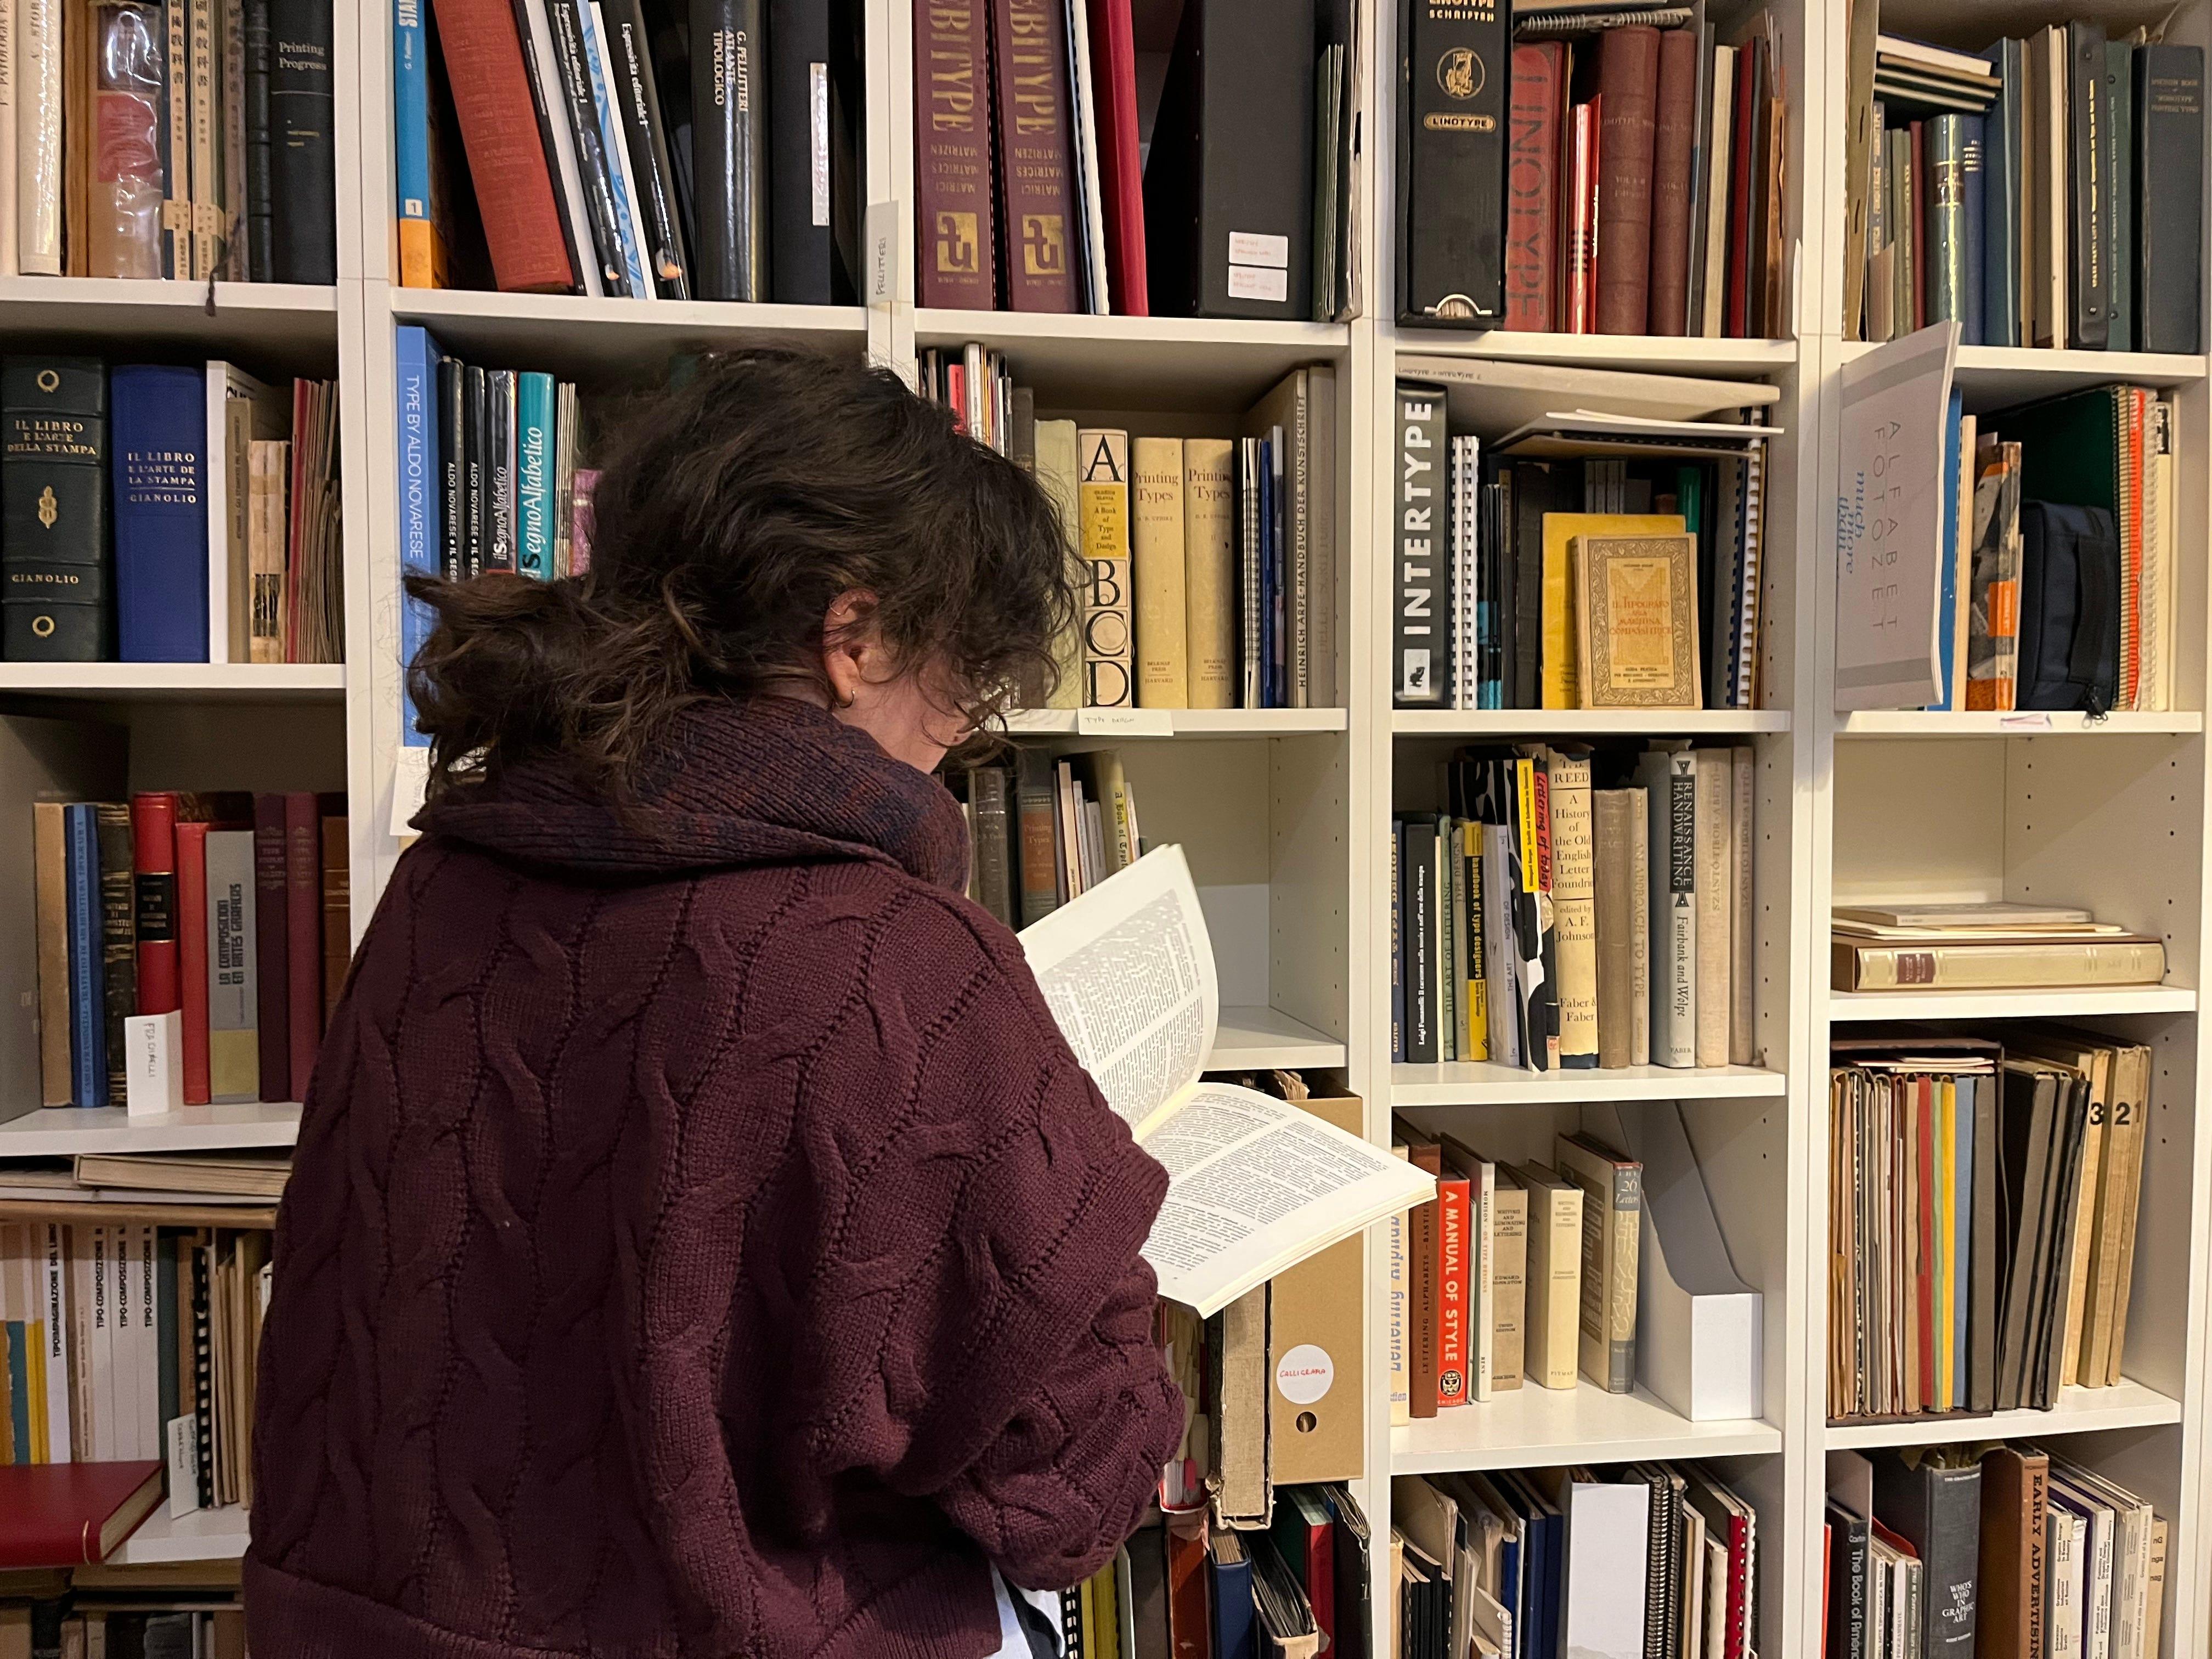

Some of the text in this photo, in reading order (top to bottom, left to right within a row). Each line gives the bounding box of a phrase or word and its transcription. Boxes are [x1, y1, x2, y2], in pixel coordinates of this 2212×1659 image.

[1429, 9, 1494, 22] SCHRIFTEN
[279, 41, 325, 56] Printing
[279, 57, 327, 71] Progress
[714, 30, 725, 105] TIPOLOGICO
[737, 30, 748, 112] G. PELLITTERI
[1432, 117, 1488, 127] LINOTYPE
[929, 144, 978, 158] MATRIZEN
[1014, 146, 1062, 160] MATRIZEN
[1015, 165, 1064, 178] MATRICES
[935, 182, 977, 194] MATRICI
[1021, 183, 1061, 195] MATRICI
[1509, 75, 1548, 317] LINOTYPE
[410, 202, 418, 214] 1
[15, 420, 84, 432] IL LIBRO
[24, 432, 74, 443] E L'ARTE
[1296, 394, 1306, 485] KUNSTSCHRIFT
[7, 443, 97, 455] DELLA STAMPA
[128, 452, 195, 462] IL LIBRO
[138, 465, 195, 475] L'ARTE DE
[406, 375, 424, 559] TYPE BY ALDO NOVARESE
[147, 476, 195, 486] STAMPA
[130, 493, 197, 504] GIANOLIO
[1138, 487, 1174, 504] Types
[1194, 485, 1231, 501] Types
[448, 462, 457, 556] ALDO NOVARESE IL
[471, 462, 479, 555] ALDO NOVARESE IL
[1296, 490, 1305, 514] DER
[1854, 471, 1865, 539] much
[492, 466, 511, 561] ilSegnoAlfabetico
[1404, 402, 1432, 635] INTERTYPE
[1098, 524, 1114, 534] Type
[1096, 542, 1117, 551] Design
[1846, 512, 1854, 574] more
[11, 574, 79, 584] GIANOLIO
[1297, 629, 1306, 688] HEINRICH
[1087, 660, 1129, 707] D
[1554, 771, 1588, 785] REED
[1569, 795, 1578, 805] A
[1115, 803, 1126, 837] Book of
[1555, 808, 1590, 820] History
[1536, 775, 1550, 888] Lettering of today
[1568, 822, 1578, 831] of
[1555, 836, 1591, 846] the Old
[1673, 782, 1683, 886] HANDWRITING
[1684, 782, 1692, 886] RENAISSANCE
[1712, 822, 1720, 856] TIBOR
[1556, 850, 1591, 862] English
[1453, 842, 1463, 903] TYPE DESIGN
[1560, 865, 1589, 874] Letter
[1443, 882, 1452, 941] LETTERING
[1473, 901, 1481, 911] of
[1503, 900, 1509, 910] OF
[1559, 905, 1591, 916] edited by
[1472, 914, 1481, 933] type
[1565, 916, 1588, 926] A. F.
[1635, 844, 1645, 998] AN APPROACH TO TYPE
[231, 935, 243, 968] ARTES
[1444, 947, 1451, 961] OF
[1473, 935, 1482, 978] designers
[1674, 916, 1688, 1017] Fairbank and Wolpe
[218, 973, 230, 985] LA
[231, 971, 244, 985] EN
[1560, 998, 1590, 1008] Faber
[1566, 1012, 1594, 1022] Faber
[1418, 1028, 1426, 1045] Luigi
[2090, 1102, 2131, 1125] 3 2
[1620, 1177, 1638, 1192] 26
[1445, 1190, 1459, 1361] A MANUAL OF STYLE
[2032, 1474, 2042, 1536] EARLY
[1851, 1549, 1864, 1619] The Book of
[1949, 1581, 1972, 1593] WHO'S
[1953, 1589, 1970, 1600] WHO
[1942, 1602, 1975, 1617] GRAPHIC
[1957, 1599, 1966, 1607] IN
[1953, 1612, 1967, 1624] ART
